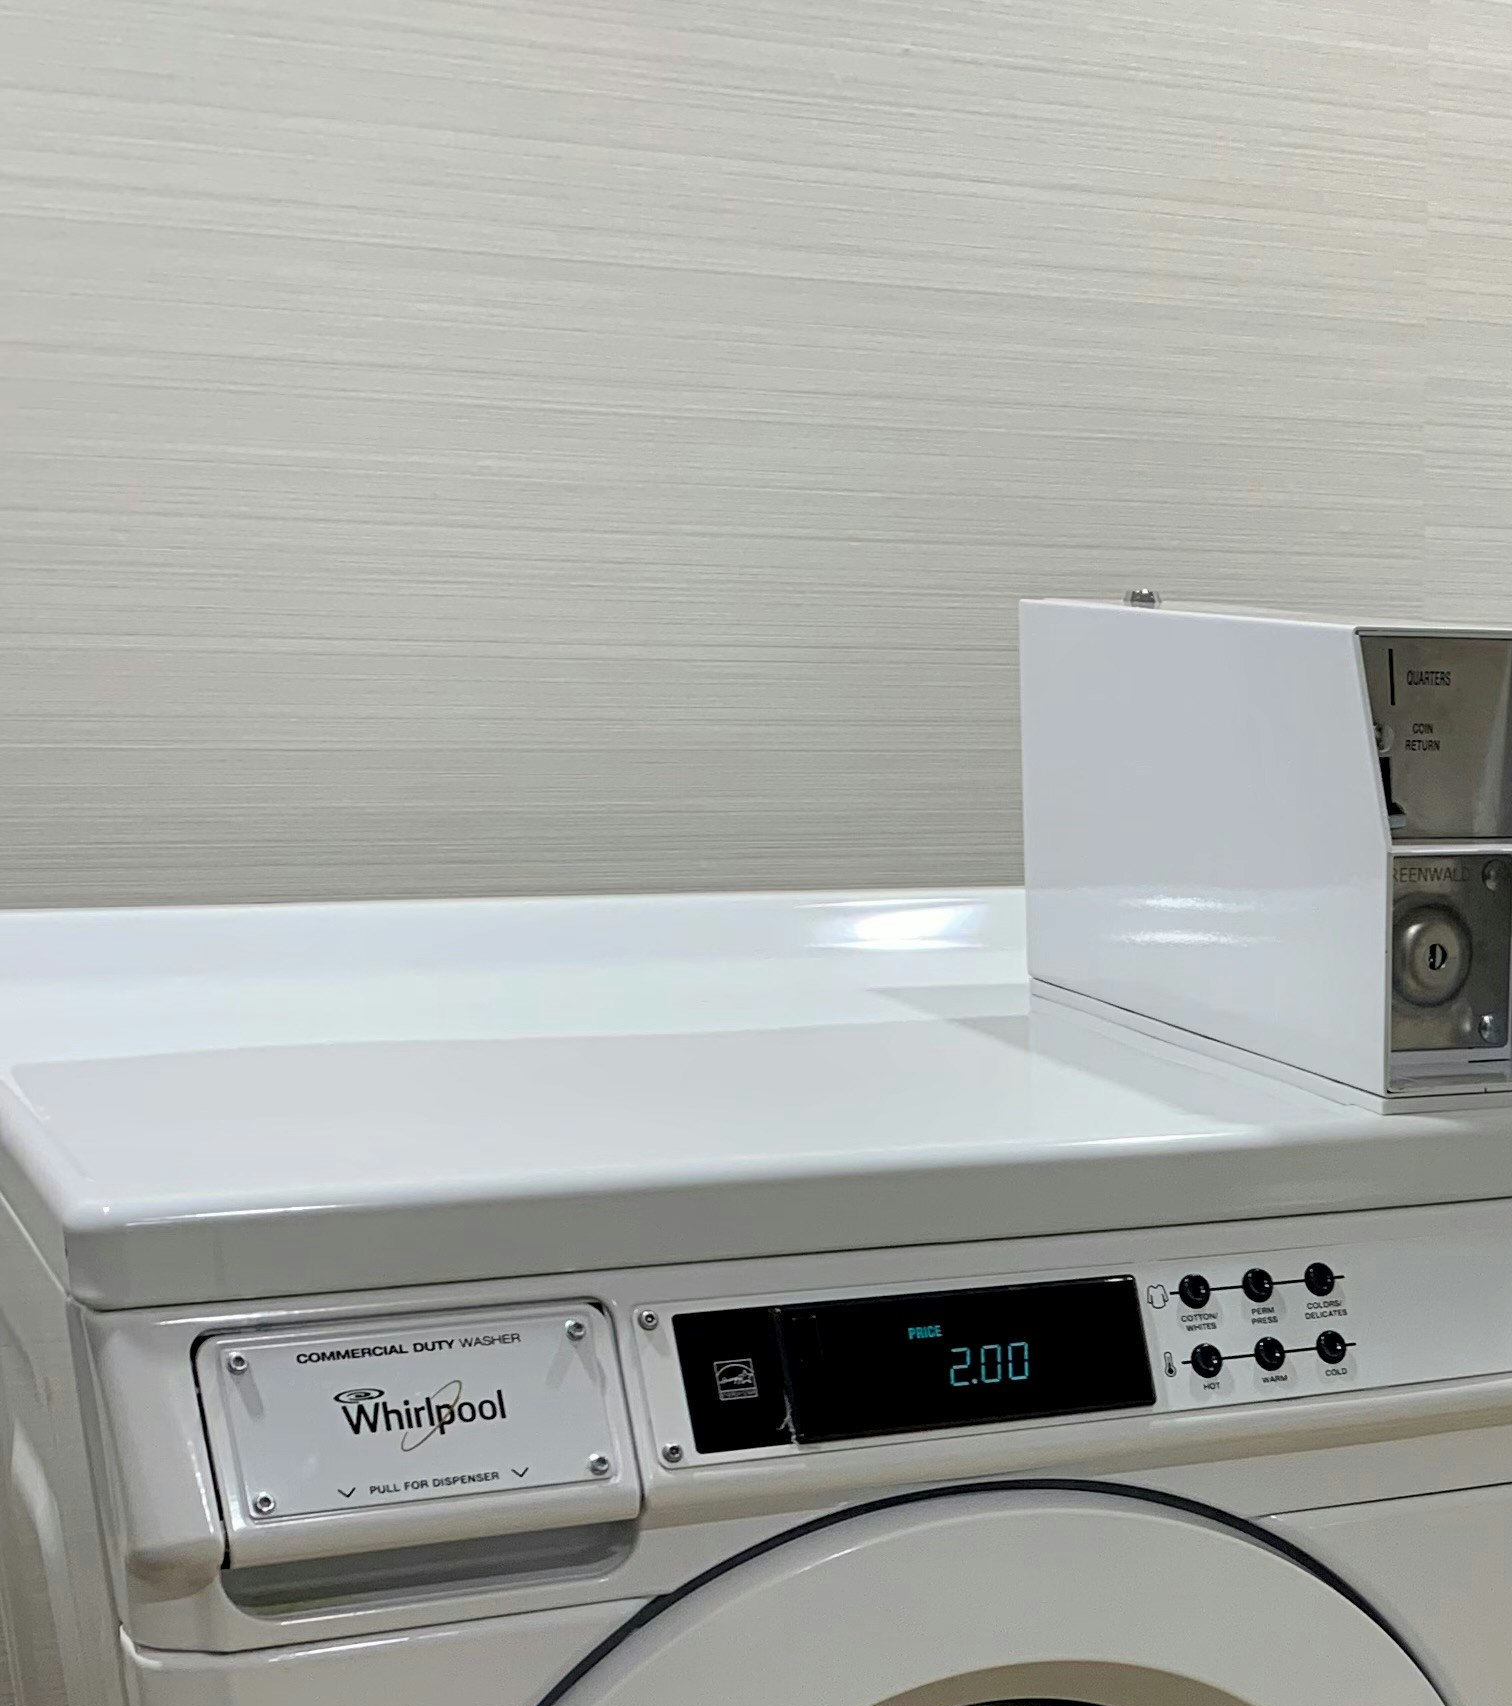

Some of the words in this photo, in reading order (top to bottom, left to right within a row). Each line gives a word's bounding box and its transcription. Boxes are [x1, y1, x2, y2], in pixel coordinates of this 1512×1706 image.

[1406, 670, 1451, 686] QUARTERS
[1412, 723, 1433, 734] COIN
[1405, 739, 1440, 751] RETURN
[1251, 1306, 1275, 1315] PERM
[1304, 1309, 1349, 1320] DELICATES
[1186, 1323, 1217, 1331] WHITES
[1251, 1316, 1279, 1325] PRESS
[908, 1325, 943, 1339] PRICE
[296, 1344, 408, 1364] COMMERCIAL
[413, 1339, 455, 1353] DUTY
[458, 1333, 521, 1348] WASHER
[950, 1341, 1029, 1386] 2.00
[1203, 1382, 1220, 1390] HOT
[1262, 1375, 1288, 1383] WARM
[1325, 1368, 1348, 1377] COLD
[342, 1389, 507, 1435] Whirlpool
[369, 1483, 400, 1495] PULL
[404, 1479, 429, 1491] FOR
[432, 1471, 500, 1488] DISPENSER
